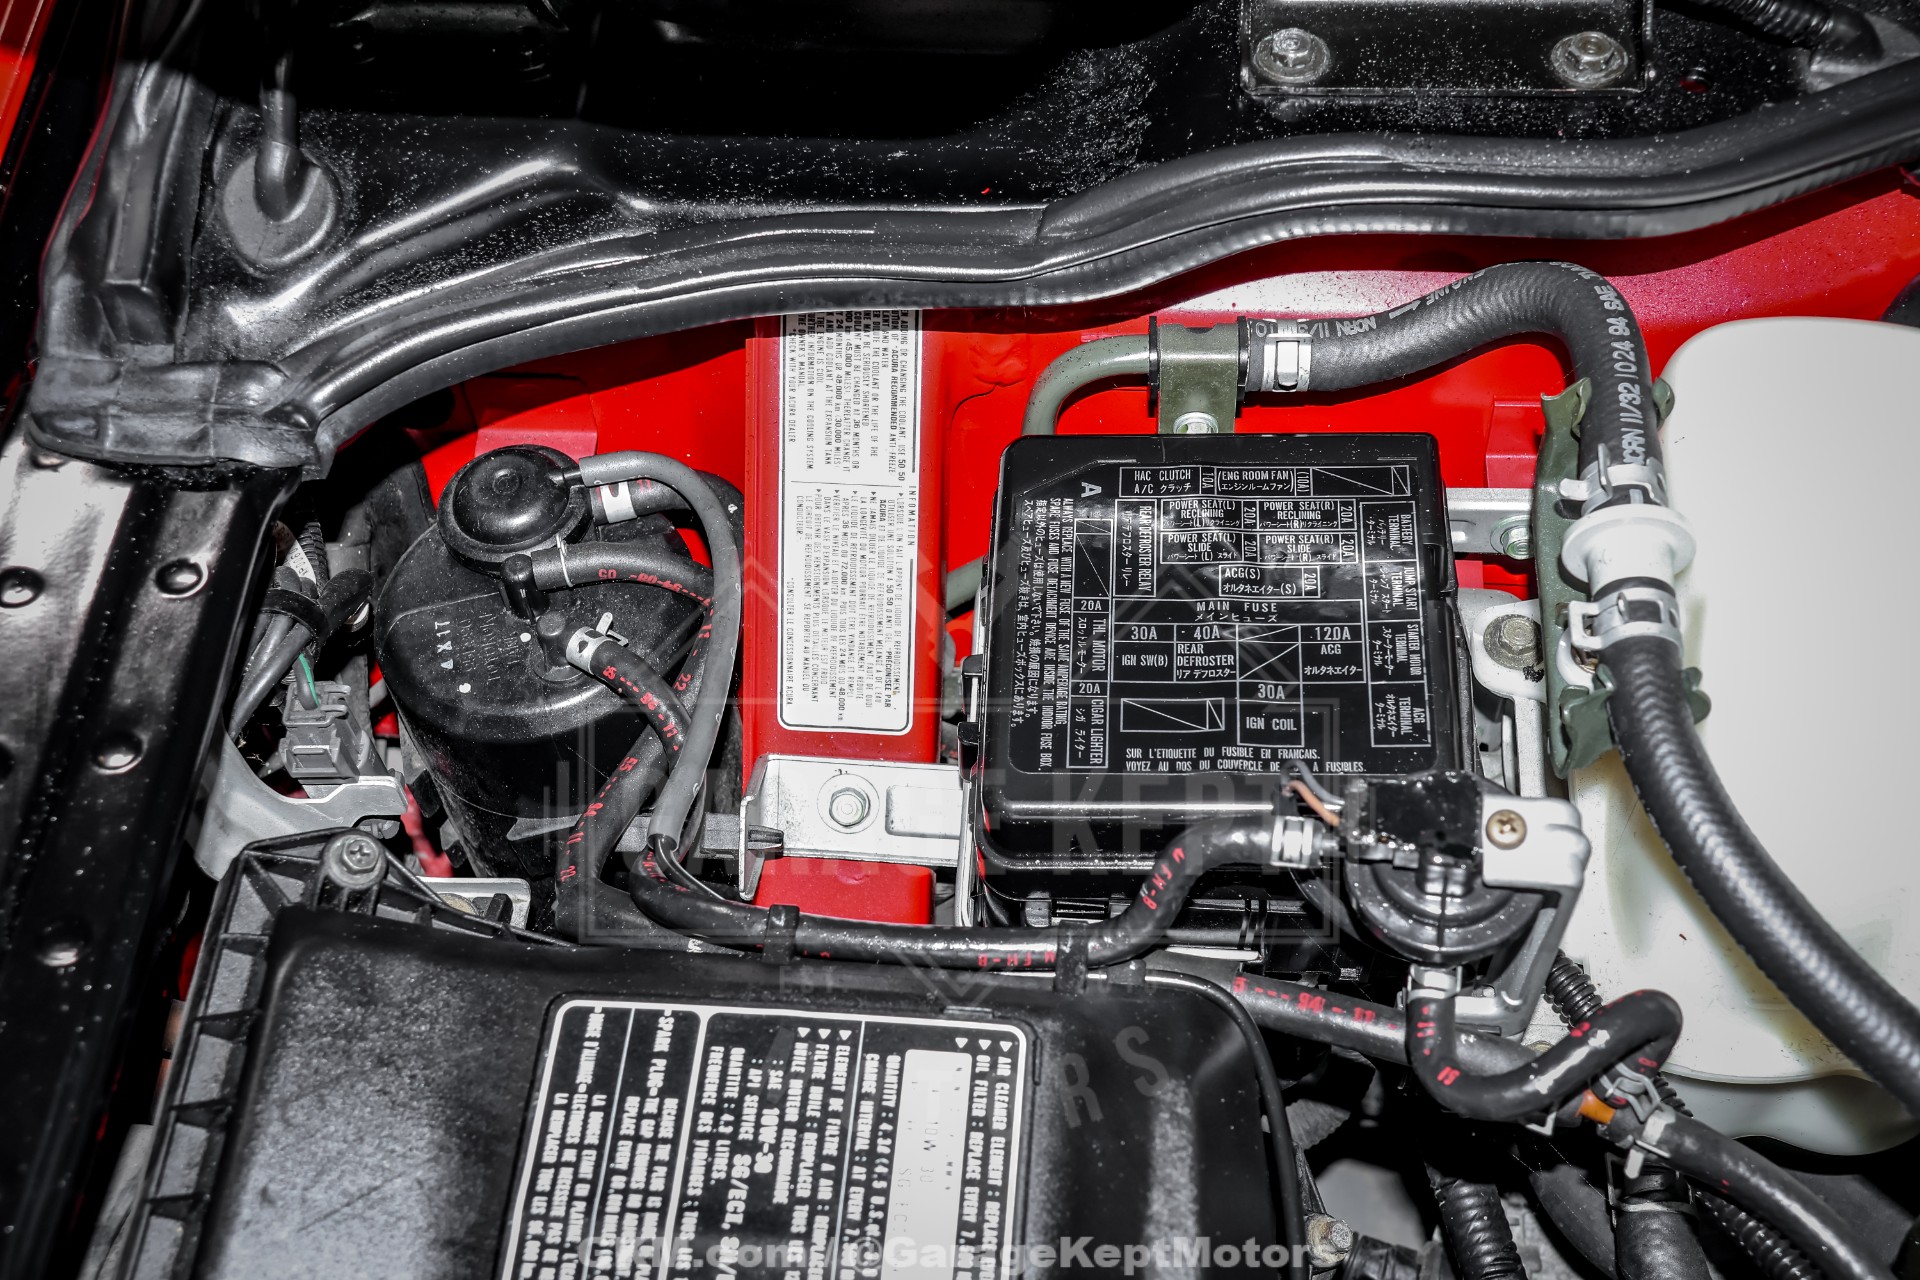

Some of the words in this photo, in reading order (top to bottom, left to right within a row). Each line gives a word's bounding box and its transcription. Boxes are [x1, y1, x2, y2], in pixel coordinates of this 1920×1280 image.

[1606, 316, 1631, 336] 94
[1134, 470, 1151, 481] HAC
[1159, 469, 1191, 481] CLUTCH
[1242, 471, 1270, 481] ROOM
[1134, 483, 1154, 494] A/C
[1049, 498, 1061, 517] SPARE
[1062, 498, 1074, 523] ALWAYS
[1169, 501, 1199, 510] POWER
[1201, 500, 1236, 511] SEAT(L)
[1264, 501, 1294, 511] POWER
[1299, 501, 1335, 511] SEAT(R)
[1180, 509, 1224, 519] RECLINING
[1243, 506, 1256, 525] 20A
[1277, 510, 1321, 520] RECLINING
[1340, 505, 1353, 524] 20A
[1049, 521, 1060, 540] FUSES
[1388, 515, 1401, 549] TERMINAL
[1400, 514, 1413, 546] BATTERY
[1062, 526, 1073, 553] REPLACE
[1168, 533, 1199, 543] POWER
[1201, 533, 1237, 543] SEAT(L)
[1265, 535, 1295, 544] POWER
[1298, 534, 1334, 544] SEAT(R)
[1049, 542, 1059, 554] AND
[1139, 527, 1152, 566] DEFROSTER
[1188, 543, 1212, 552] SLIDE
[1244, 540, 1256, 558] 20A
[1287, 544, 1311, 553] SLIDE
[1342, 539, 1355, 557] 20A
[1048, 559, 1058, 574] FUSE
[1060, 557, 1071, 572] WITH
[1138, 569, 1152, 592] RELAY
[1224, 568, 1261, 579] ACG(S)
[1404, 567, 1416, 585] JUMP
[1060, 581, 1071, 594] NEW
[1304, 573, 1317, 590] 20A
[1391, 571, 1404, 607] TERMINAL
[1046, 578, 1058, 619] DETACHMENT
[1059, 598, 1070, 614] FUSE
[1080, 600, 1102, 611] 20A
[1405, 588, 1417, 610] START
[1196, 601, 1230, 611] MAIN
[1244, 602, 1277, 612] FUSE
[1058, 619, 1070, 627] OF
[1093, 619, 1106, 635] THL
[1044, 622, 1056, 644] DEVICE
[1058, 629, 1070, 640] THE
[1131, 626, 1157, 640] 30A
[1193, 625, 1220, 640] 40A
[1315, 626, 1351, 640] 120A
[1407, 624, 1419, 650] STARTER
[1044, 648, 1056, 660] ARE
[1058, 644, 1069, 662] SAME
[1092, 640, 1106, 671] MOTOR
[1177, 644, 1204, 654] REAR
[1320, 644, 1342, 655] ACG
[1395, 633, 1408, 663] TERMINAL
[1121, 654, 1136, 666] IGN
[1140, 654, 1168, 667] SW(B)
[1177, 654, 1235, 667] DEFROSTER
[1409, 654, 1422, 676] MOTOR
[1043, 664, 1055, 685] INSIDE
[1056, 664, 1068, 699] AMPERAGE
[1042, 688, 1054, 700] THE
[1080, 683, 1100, 693] 20A
[1257, 683, 1285, 700] 30A
[1041, 705, 1053, 730] INDOOR
[1091, 699, 1104, 725] CIGAR
[1399, 697, 1413, 735] TERMINAL
[1412, 708, 1425, 723] ACG
[1246, 716, 1265, 730] IGN
[1272, 718, 1297, 731] COIL
[1040, 733, 1052, 749] FUSE
[1090, 728, 1104, 764] LIGHTER
[1126, 748, 1142, 758] SUR
[1149, 747, 1197, 759] L'ETIQUETTE
[1203, 747, 1215, 757] DU
[1221, 746, 1254, 758] FUSIBLE
[1260, 749, 1271, 759] EN
[1125, 760, 1151, 772] VOYEZ
[1158, 761, 1169, 772] AU
[1175, 761, 1192, 772] DOS
[1199, 759, 1210, 770] DU
[1216, 759, 1263, 772] COUVERCLE
[1270, 761, 1280, 772] DE
